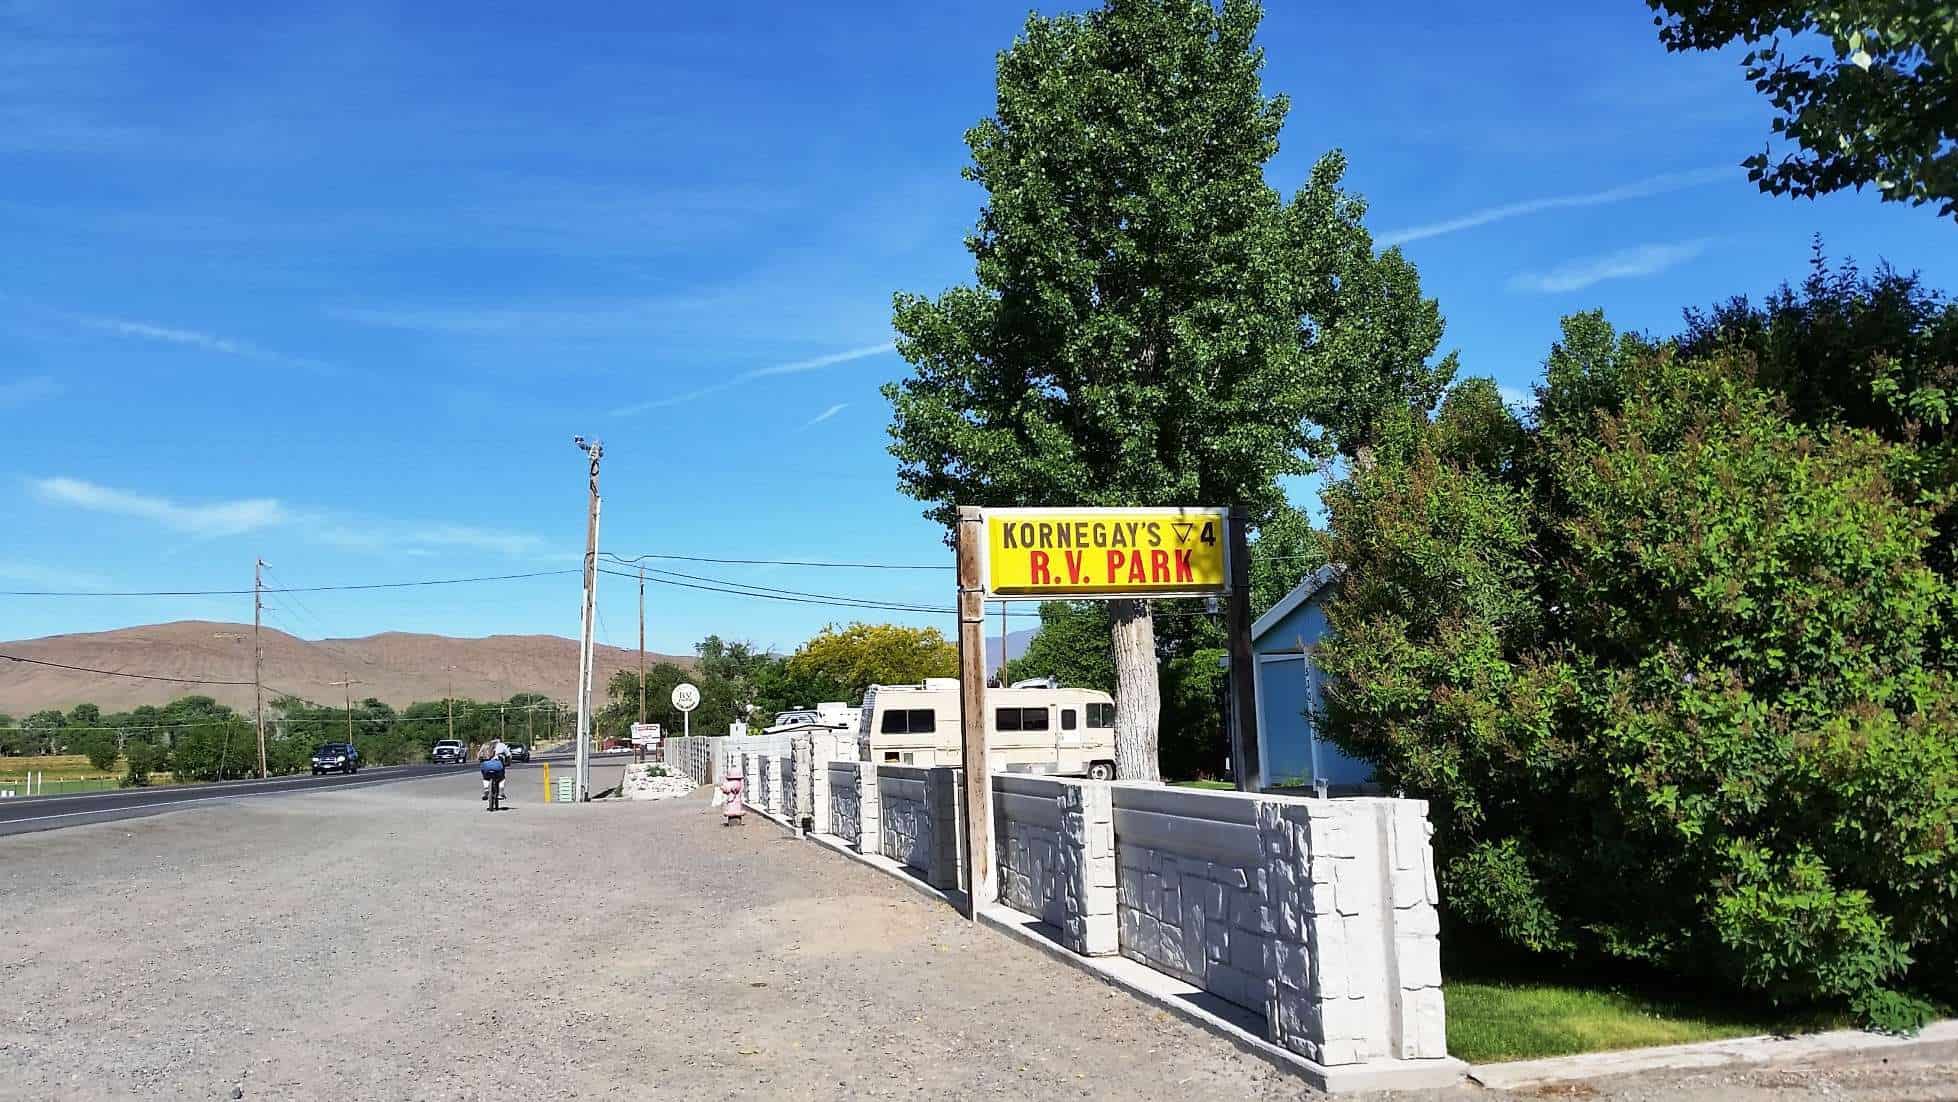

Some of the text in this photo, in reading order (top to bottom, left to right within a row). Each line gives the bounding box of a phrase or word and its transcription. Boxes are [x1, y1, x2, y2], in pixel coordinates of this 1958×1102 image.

[1004, 522, 1161, 548] KORNEGAY'S
[1031, 549, 1194, 584] R.V. PARK
